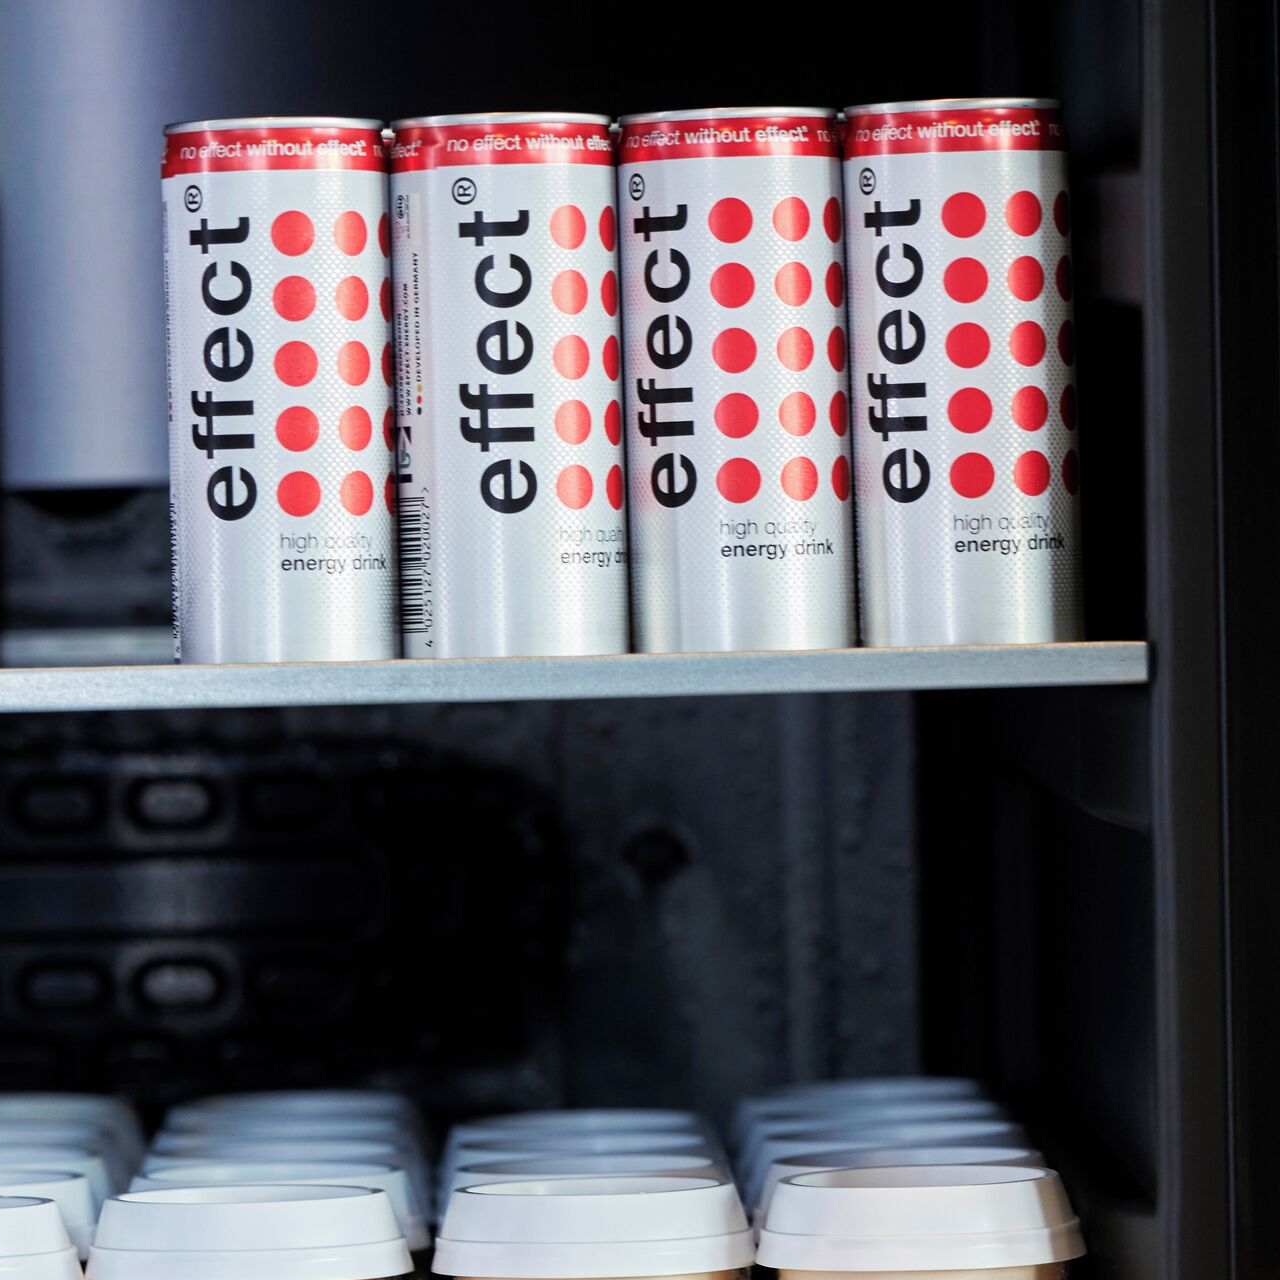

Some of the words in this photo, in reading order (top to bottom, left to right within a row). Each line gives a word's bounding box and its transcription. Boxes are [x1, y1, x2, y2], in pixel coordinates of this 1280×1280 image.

[447, 137, 468, 152] no
[472, 135, 522, 151] effect
[526, 134, 584, 151] without
[586, 134, 612, 151] effec
[626, 134, 641, 149] no
[642, 129, 680, 147] effect
[684, 126, 750, 145] without
[855, 128, 871, 143] no
[871, 125, 913, 142] effect
[917, 121, 984, 139] without
[180, 145, 196, 160] no
[199, 142, 241, 159] effect
[246, 139, 314, 158] without
[411, 251, 421, 305] GERMANY
[413, 306, 421, 319] IN
[414, 320, 423, 383] DEVELOPED
[719, 518, 759, 540] high
[764, 517, 818, 538] quality
[953, 513, 992, 534] high
[998, 510, 1052, 531] quality
[279, 532, 319, 554] high
[720, 541, 786, 560] energy
[793, 538, 835, 556] drink
[953, 536, 1020, 555] energy
[1026, 534, 1066, 551] drink
[280, 555, 346, 574] energy
[352, 553, 388, 571] drink
[560, 550, 613, 569] energy
